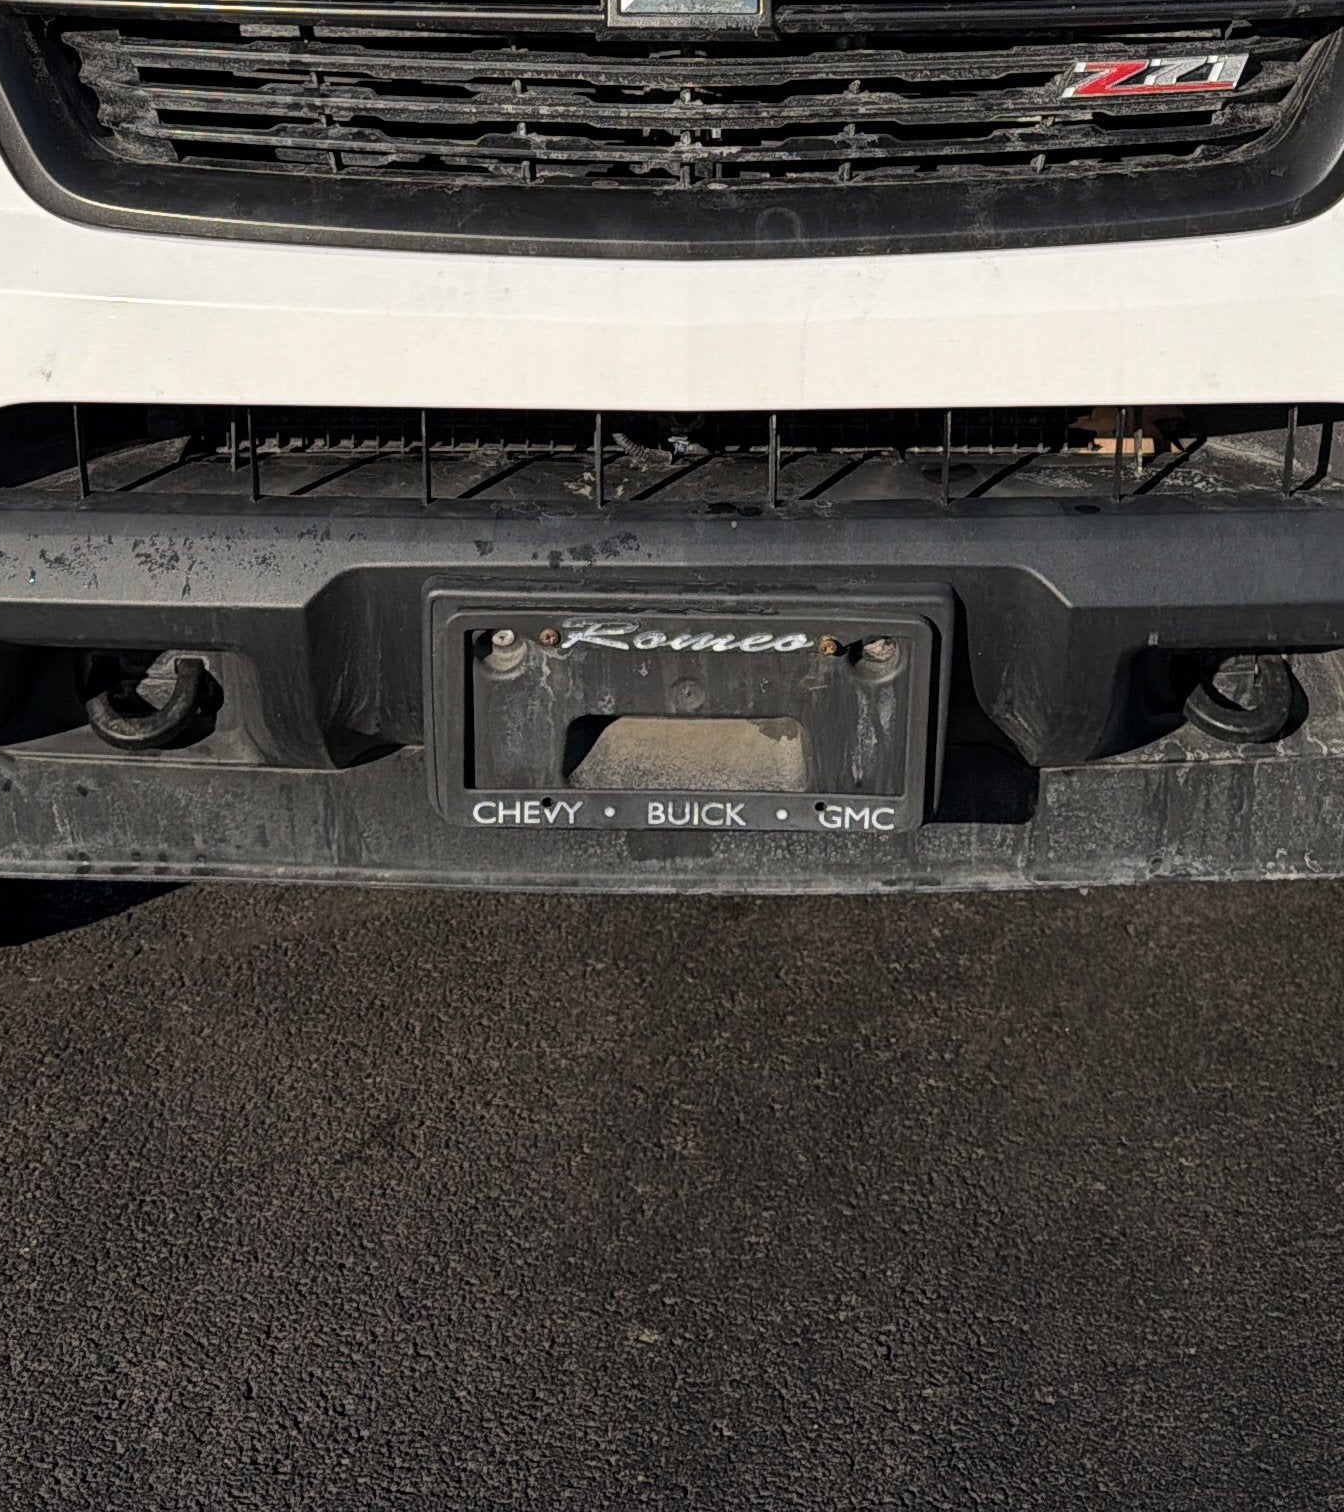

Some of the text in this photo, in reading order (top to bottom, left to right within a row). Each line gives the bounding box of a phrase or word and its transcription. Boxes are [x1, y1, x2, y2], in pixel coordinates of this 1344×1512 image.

[1061, 52, 1249, 98] Z71
[560, 616, 816, 652] Romeo
[472, 800, 896, 832] CHEVY BUICK GMC
